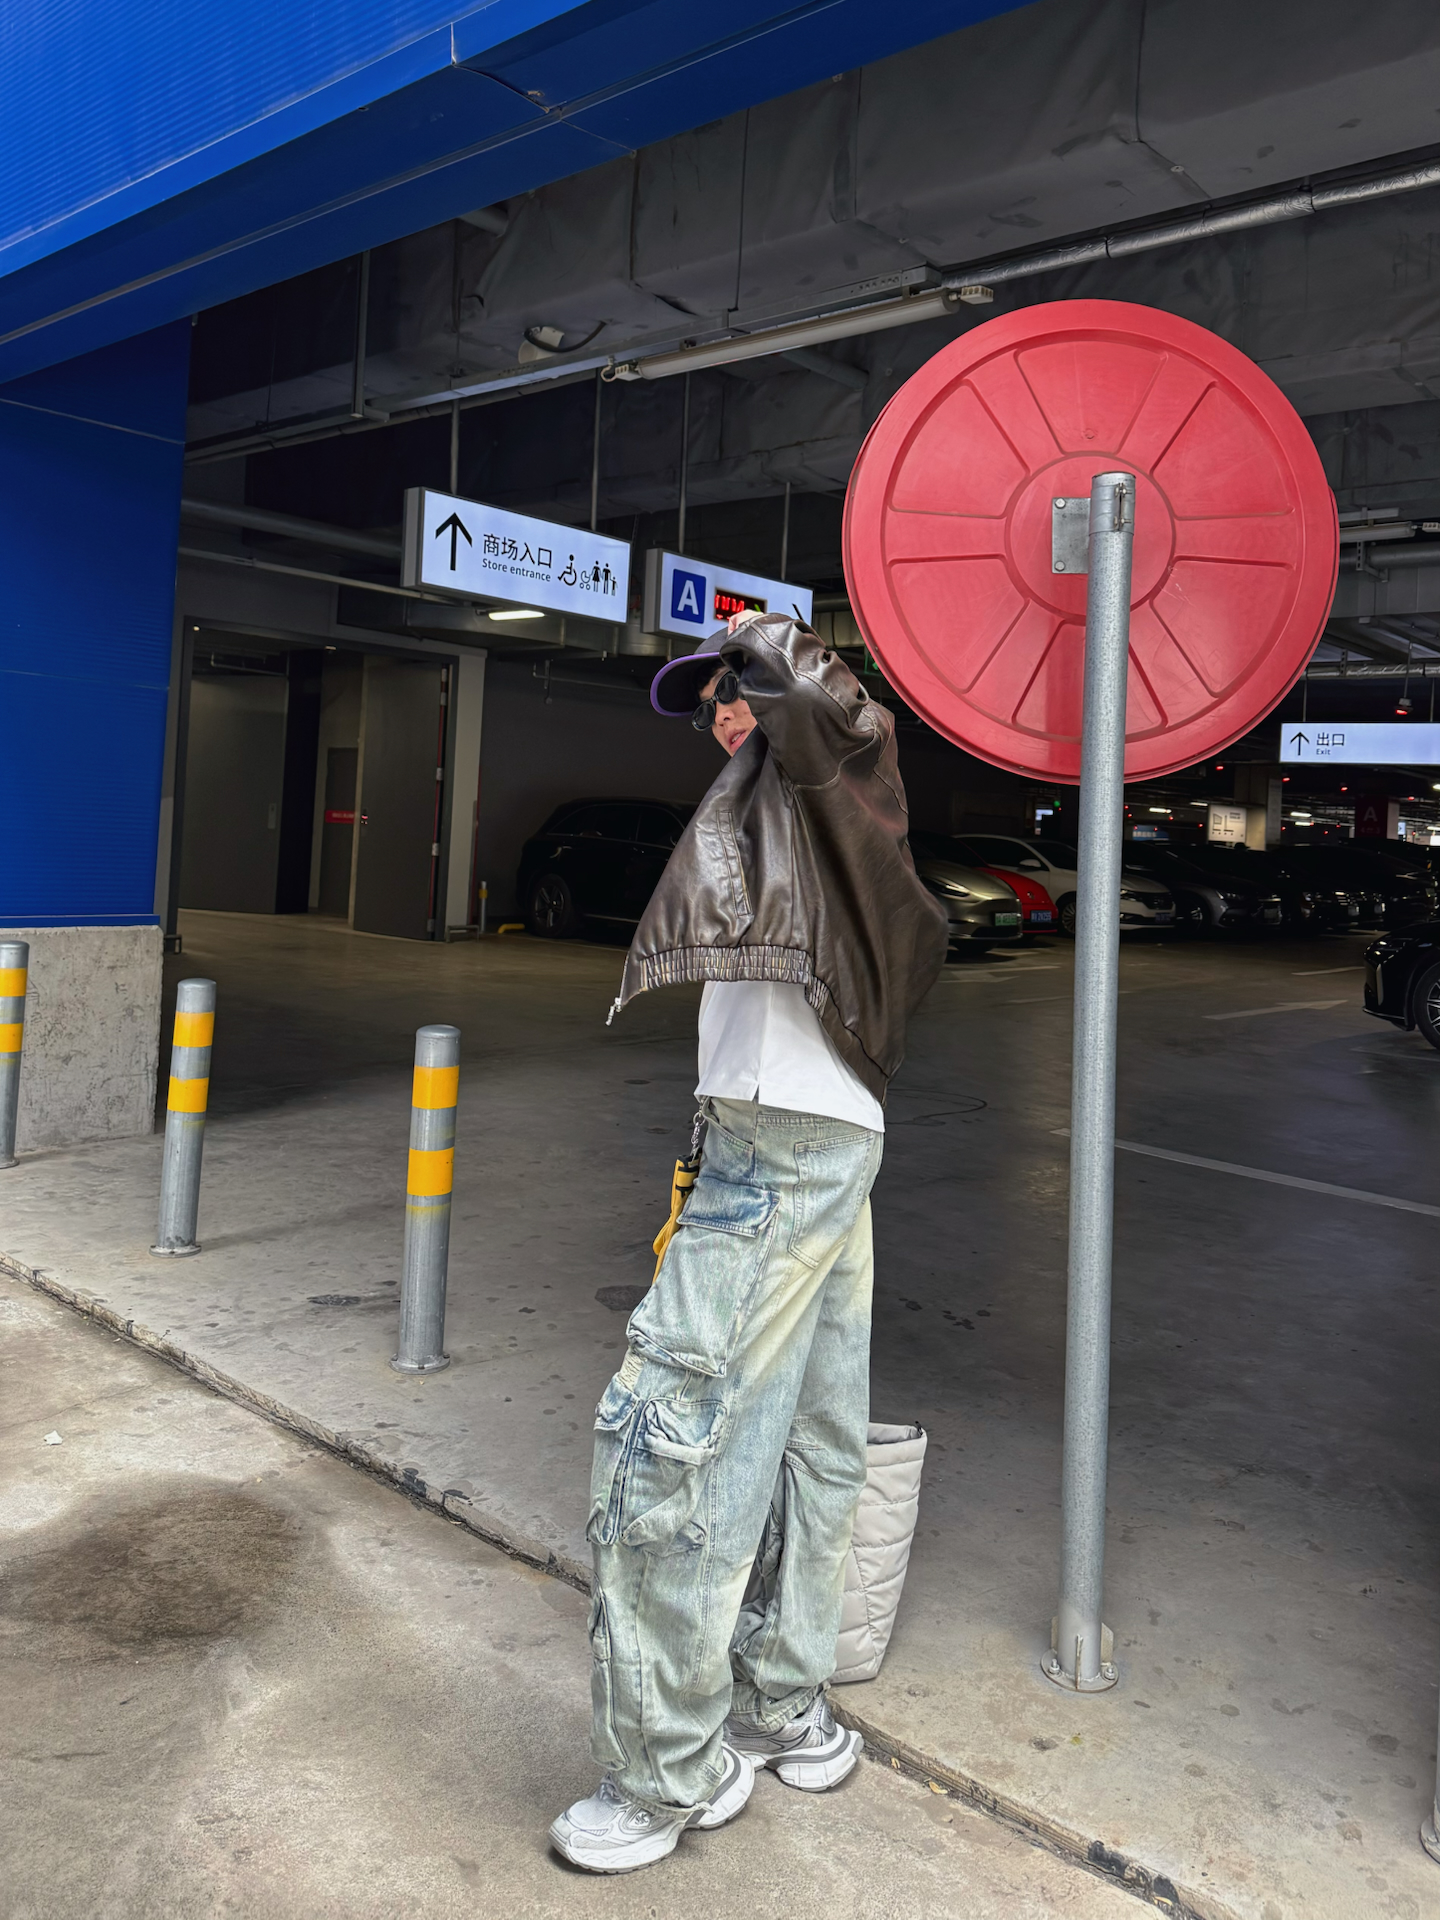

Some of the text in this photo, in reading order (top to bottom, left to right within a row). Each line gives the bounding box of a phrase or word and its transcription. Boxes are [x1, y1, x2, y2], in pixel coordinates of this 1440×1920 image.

[483, 533, 552, 569] 商场入口
[482, 558, 551, 582] Store entrance
[677, 579, 699, 616] A
[1316, 732, 1345, 746] 出口
[1363, 806, 1378, 822] A
